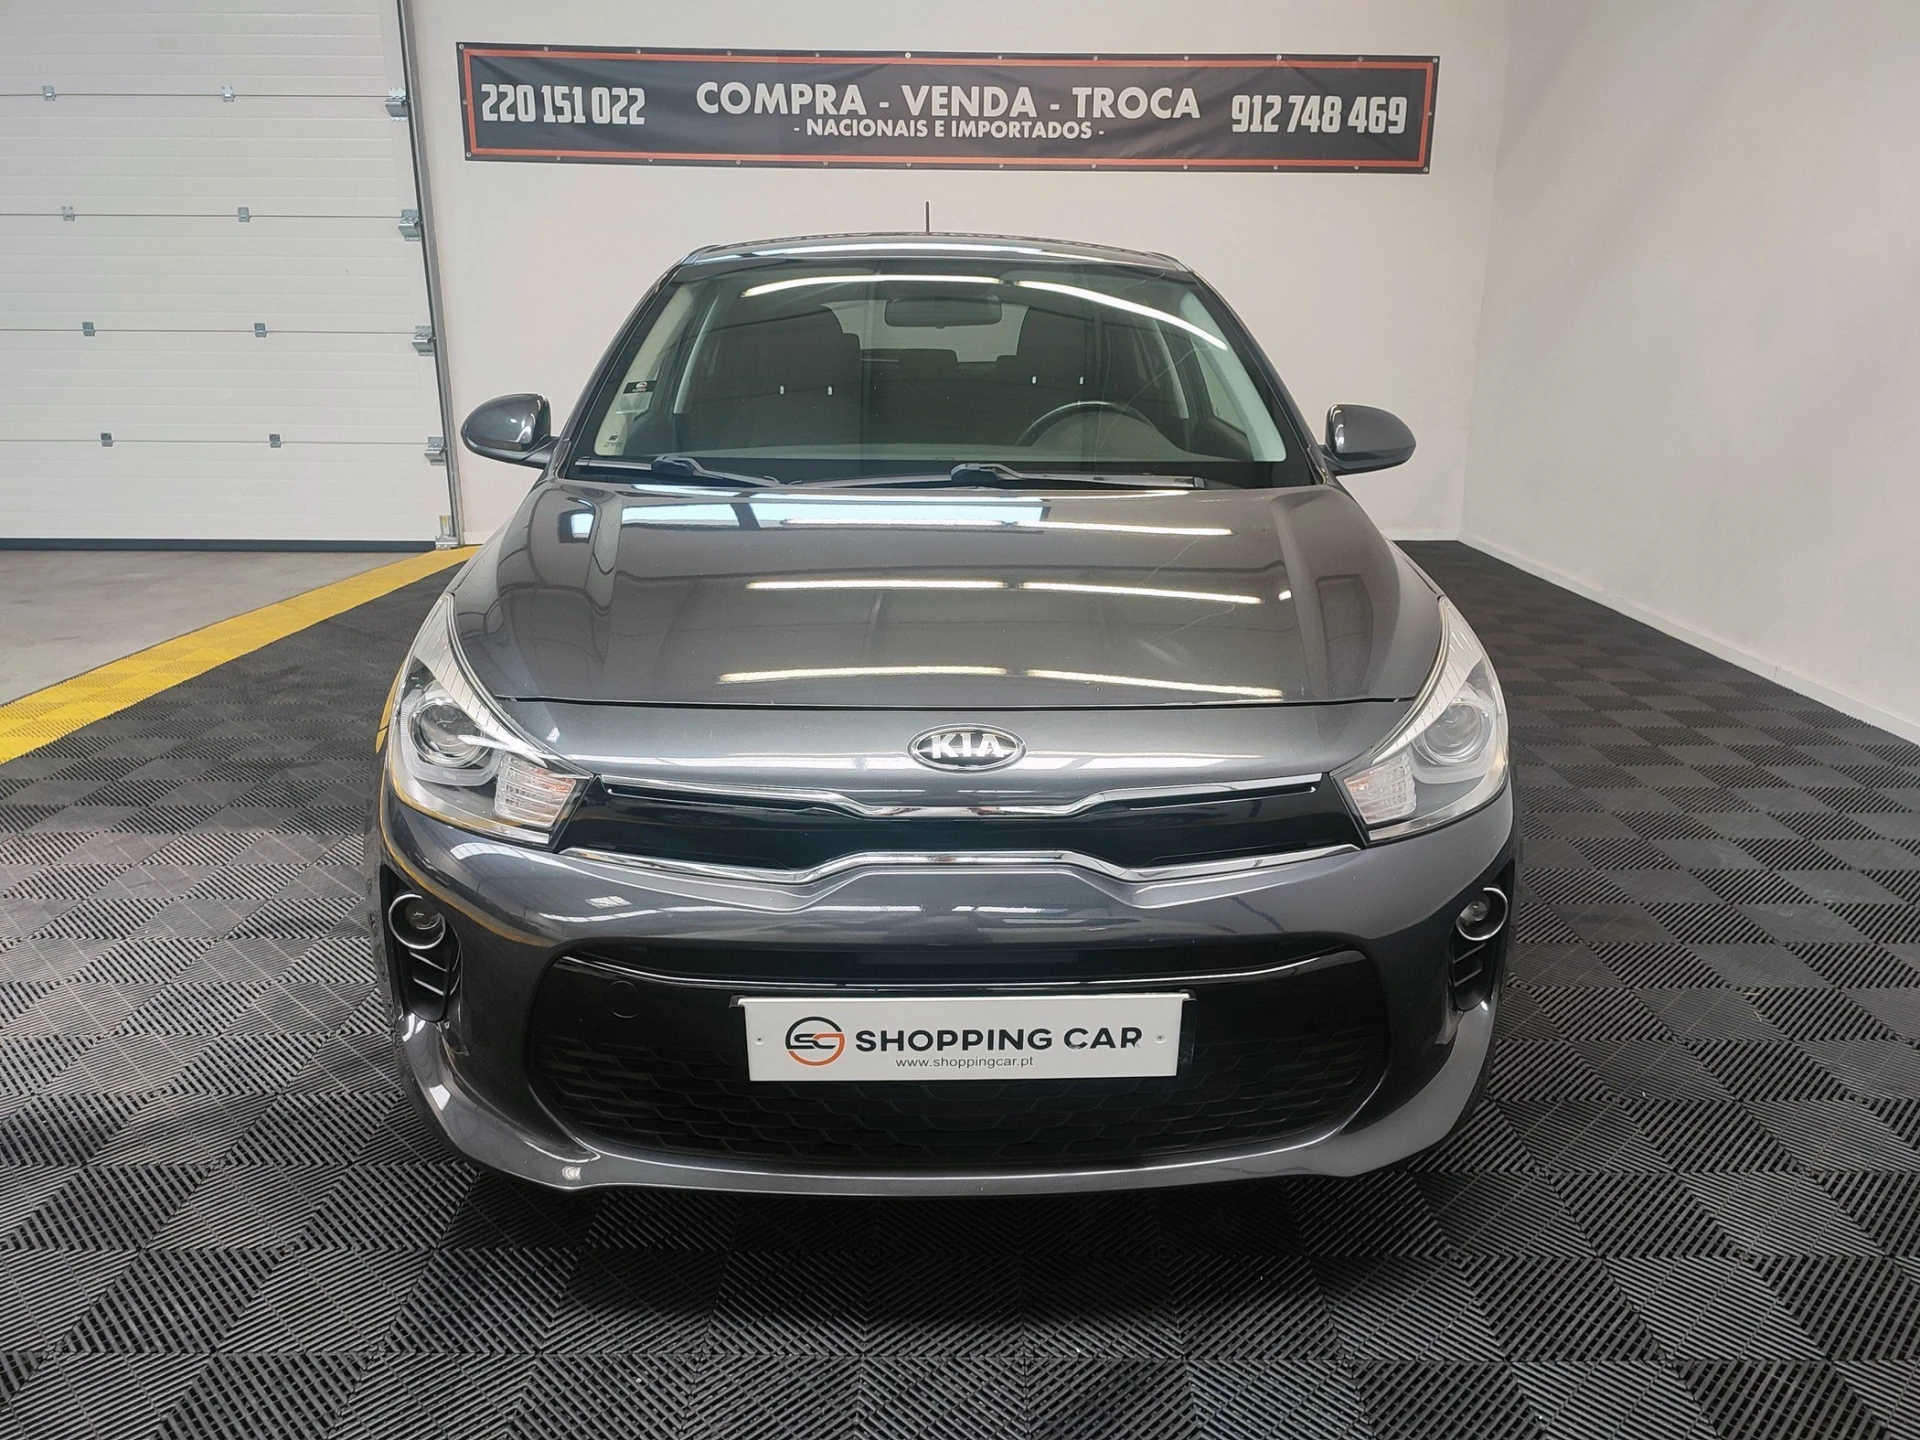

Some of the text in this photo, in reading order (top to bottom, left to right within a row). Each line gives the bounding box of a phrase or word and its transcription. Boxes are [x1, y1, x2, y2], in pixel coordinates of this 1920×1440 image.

[481, 84, 646, 125] 220 151 022
[696, 81, 867, 116] COMPRA
[902, 85, 1038, 118] VENDA
[1072, 87, 1200, 119] TROCA
[1231, 94, 1407, 134] 912 748 469
[806, 118, 928, 138] NACIONAIS
[934, 120, 944, 138] E
[951, 121, 1092, 139] IMPORTADOS
[931, 733, 1004, 758] KIA
[855, 1026, 1142, 1052] SHOPPING CAR
[895, 1055, 1034, 1069] www.shoppingcar.pt
